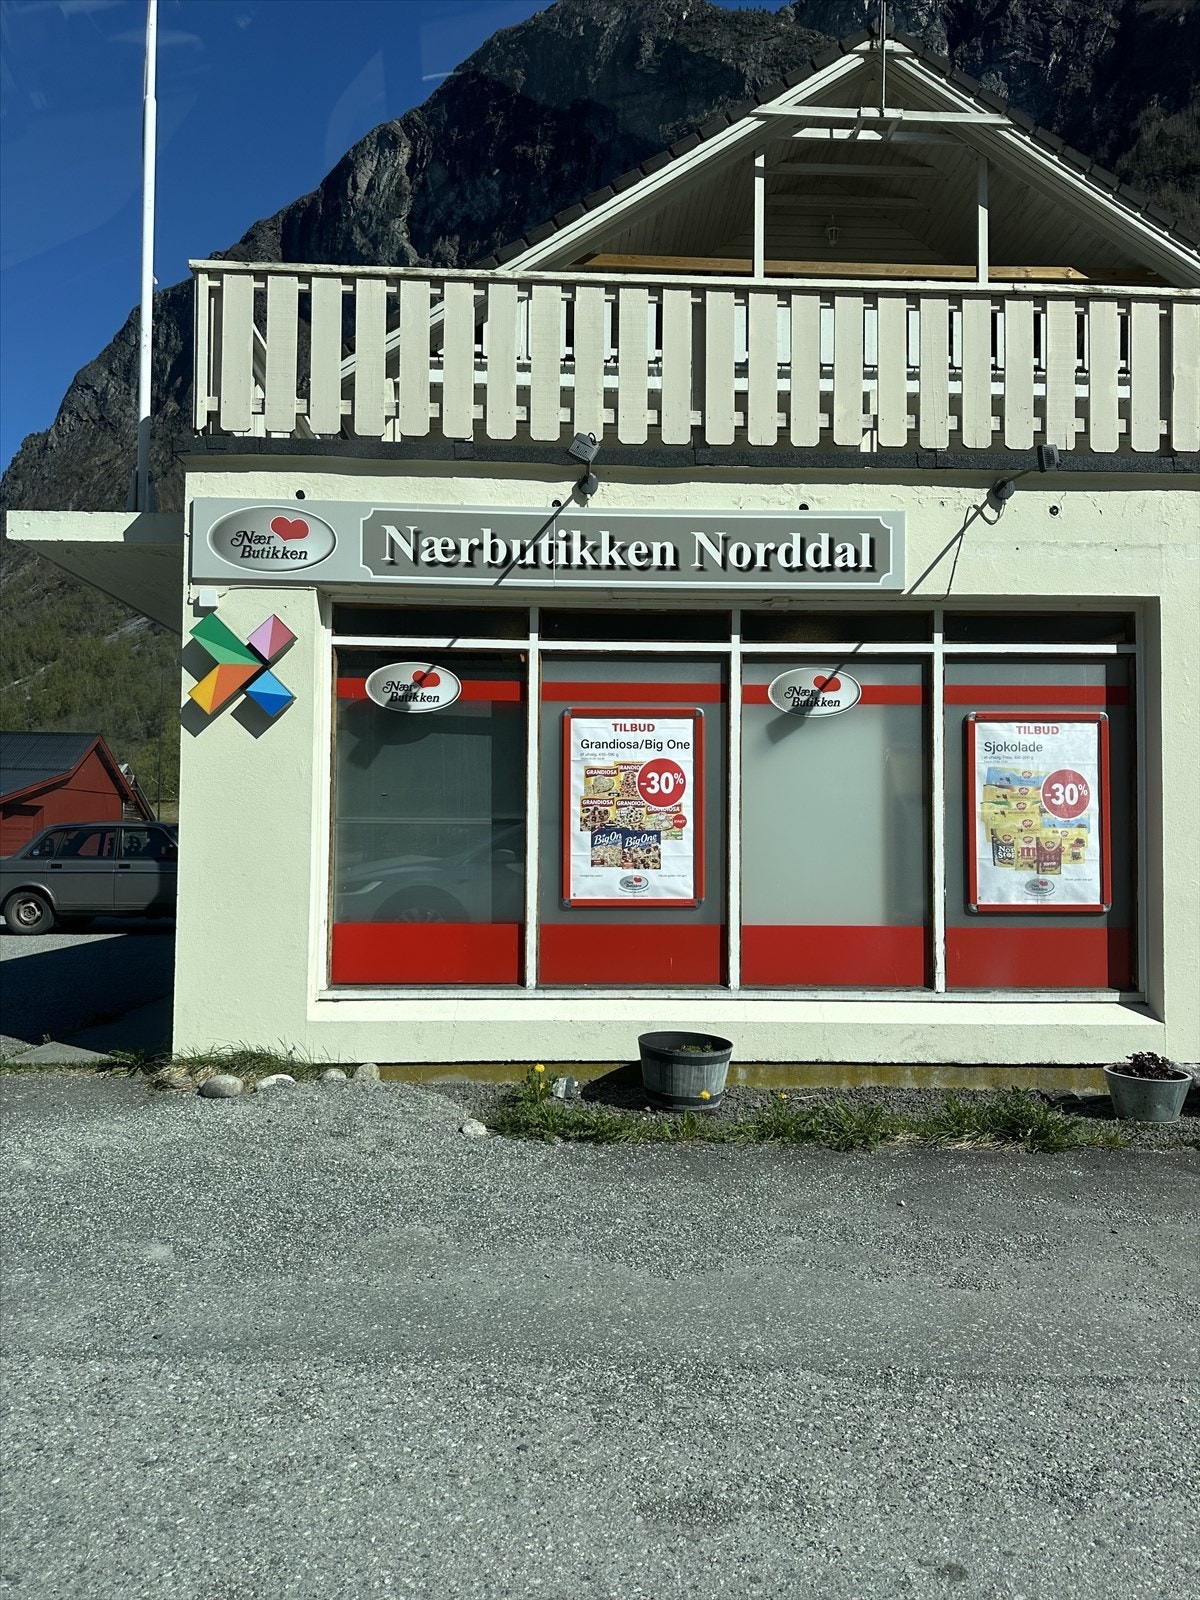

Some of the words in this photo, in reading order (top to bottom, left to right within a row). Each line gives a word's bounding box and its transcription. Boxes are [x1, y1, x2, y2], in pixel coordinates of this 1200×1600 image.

[230, 530, 275, 547] Nær
[240, 545, 309, 560] Butikken
[380, 525, 677, 567] Nærbutikken
[690, 531, 873, 568] Norddal
[382, 681, 415, 694] Nær
[784, 686, 816, 699] Nær
[390, 692, 440, 703] Butikken
[791, 697, 841, 707] Butikken
[612, 723, 655, 732] TILBUD
[1016, 725, 1060, 735] TILBUD
[580, 738, 664, 752] Grandiosa/Big
[666, 739, 690, 749] One
[984, 741, 1043, 754] Sjokolade
[640, 771, 684, 794] -30%
[1045, 783, 1088, 805] -30%
[594, 834, 609, 845] Big
[609, 831, 622, 841] On
[625, 836, 640, 847] Big
[640, 833, 657, 844] One
